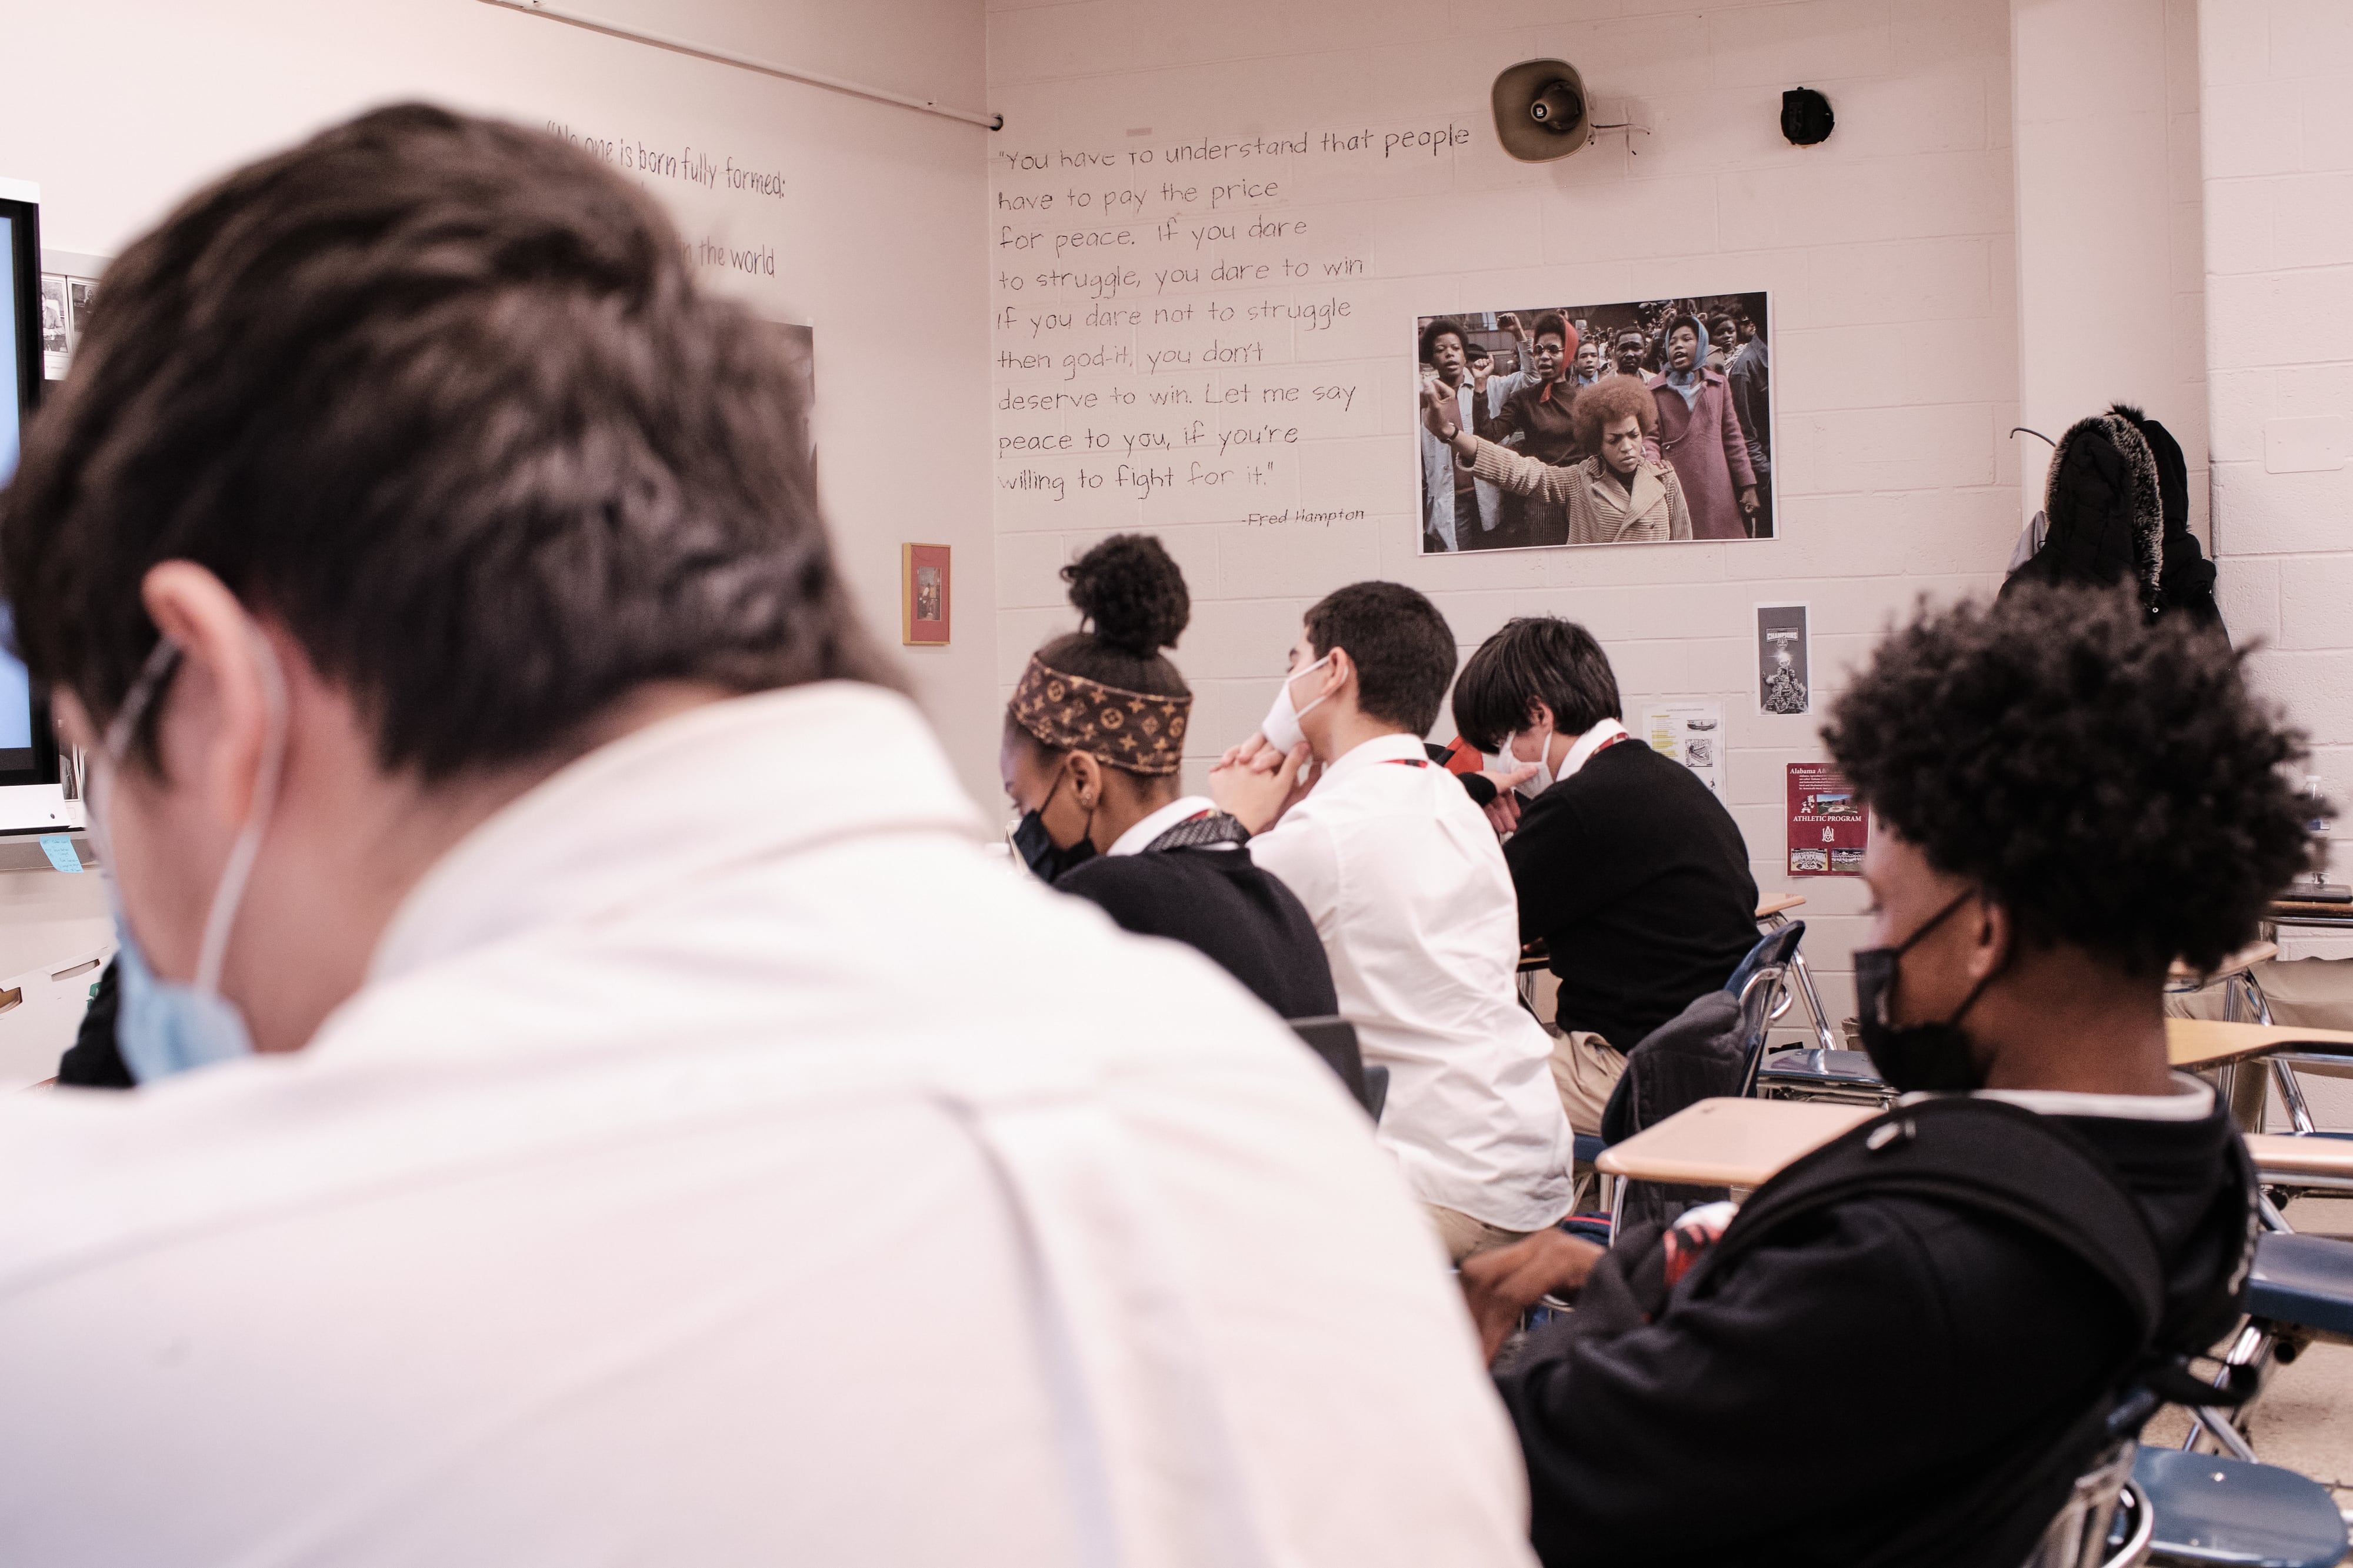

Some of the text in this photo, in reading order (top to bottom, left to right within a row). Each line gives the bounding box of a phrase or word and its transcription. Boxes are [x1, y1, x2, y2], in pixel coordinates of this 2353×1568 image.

[1060, 150, 1115, 167] have
[1166, 136, 1307, 164] understand
[1321, 129, 1374, 152] that
[1385, 124, 1469, 159] people
[585, 137, 613, 162] one
[621, 138, 632, 168] is
[638, 141, 676, 178] born
[681, 147, 717, 189] fully
[725, 156, 785, 199] formed:
[998, 179, 1278, 216] have to pay the price
[1000, 214, 1307, 258] for peace. If you dare
[699, 236, 725, 266] the
[730, 244, 775, 278] world
[999, 256, 1362, 299] to struggle, you dare to win
[998, 297, 1351, 339] If you dare not to struggle
[997, 351, 1050, 368] then
[1146, 351, 1191, 375] you
[1203, 339, 1263, 363] don't
[999, 383, 1356, 412] deserve to win. Let me say
[999, 420, 1298, 459] peace to you, if you're
[998, 469, 1064, 501] willing
[1078, 469, 1103, 488] to
[1115, 464, 1174, 500] fight
[1187, 461, 1234, 485] for
[1295, 508, 1364, 528] Hampton
